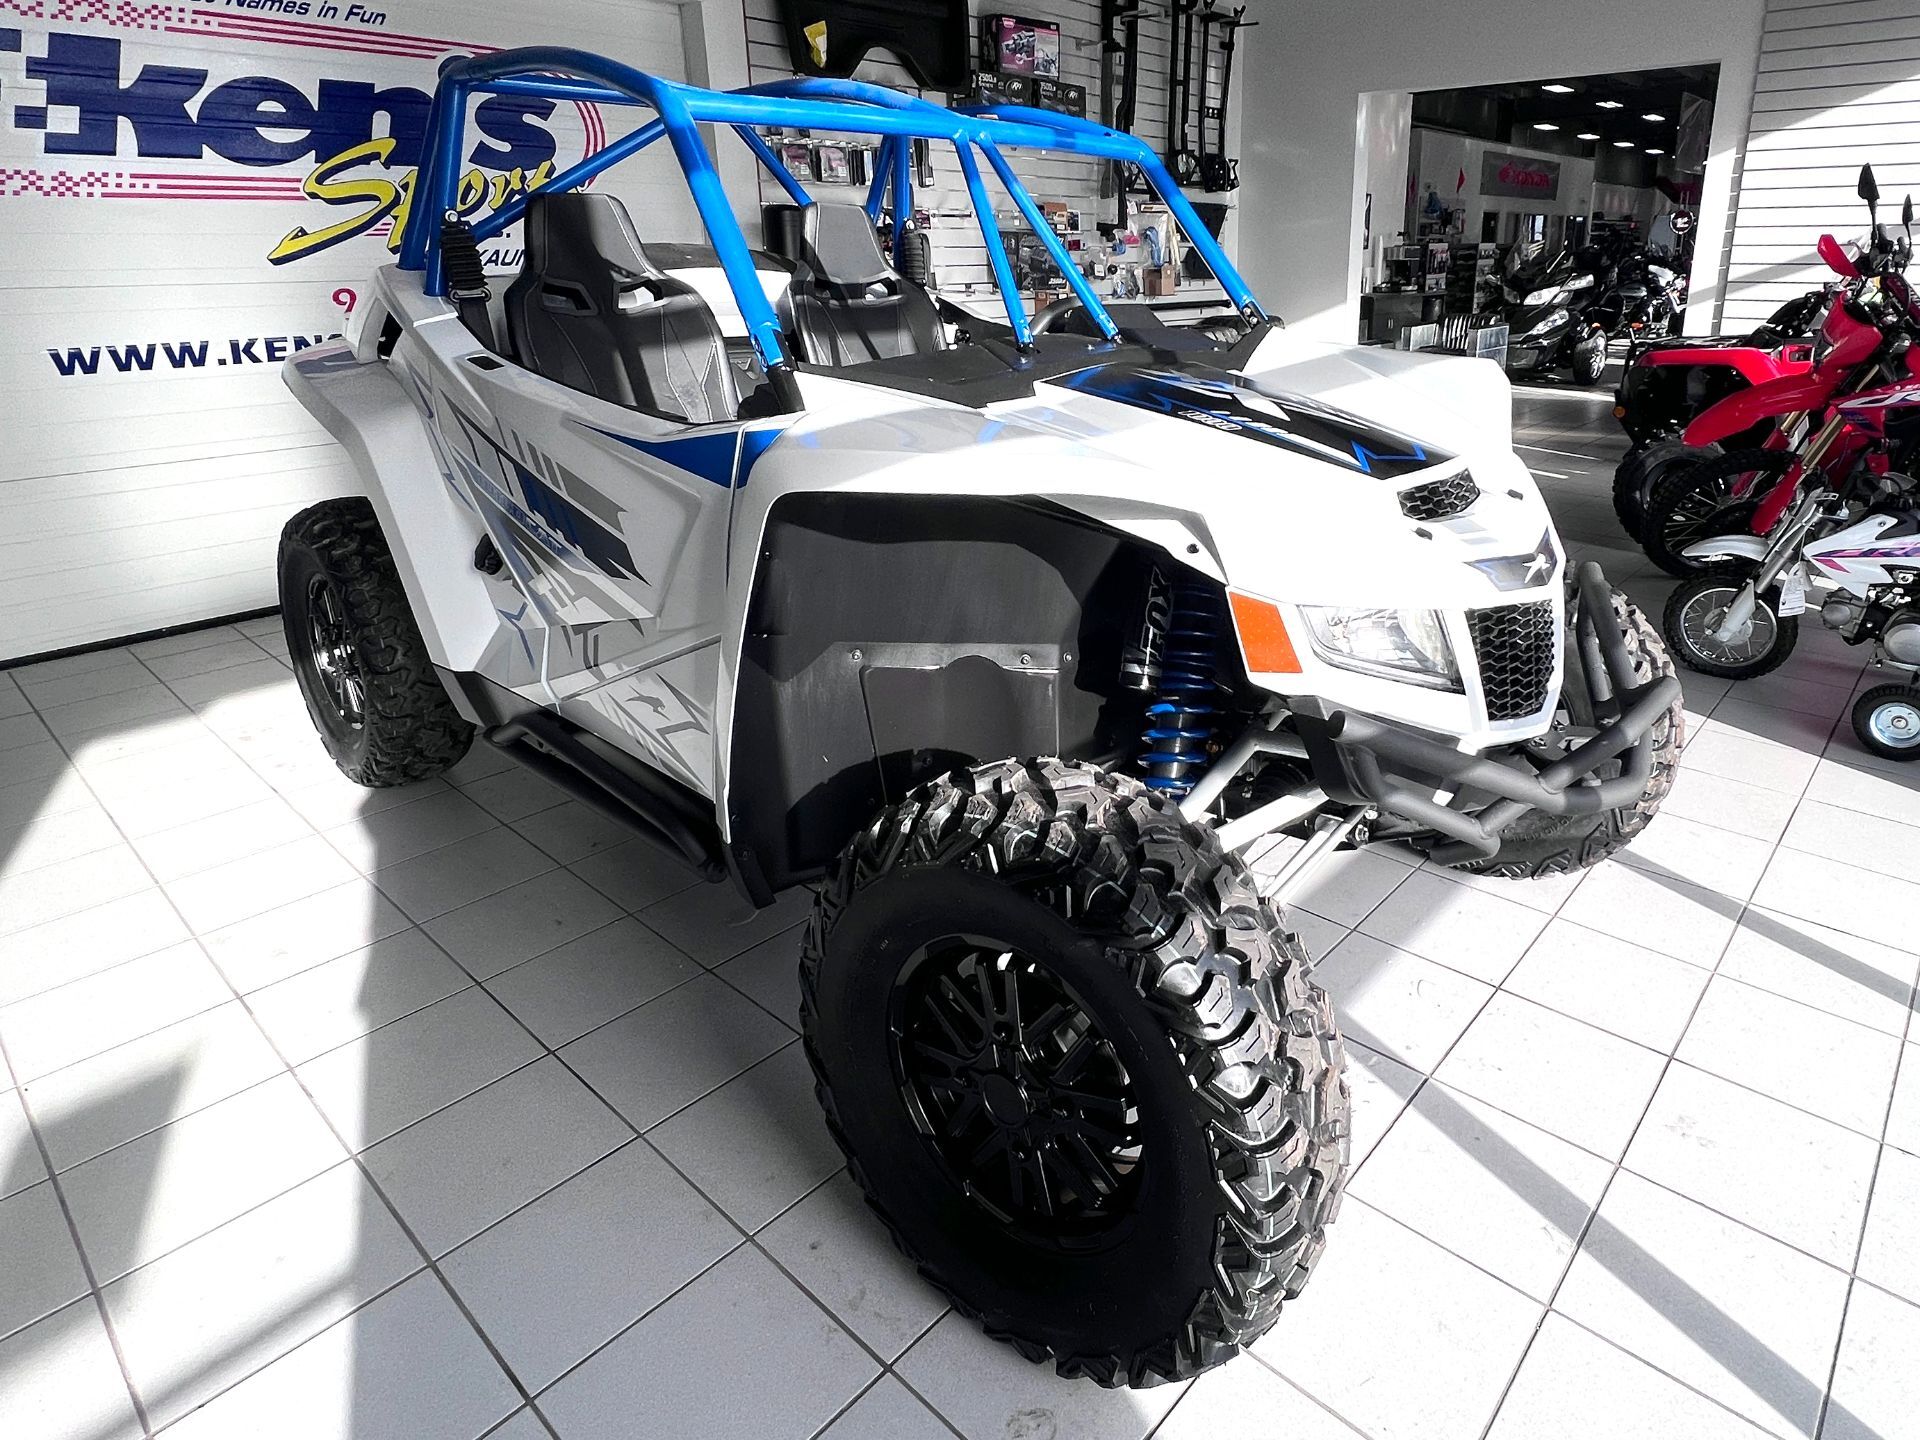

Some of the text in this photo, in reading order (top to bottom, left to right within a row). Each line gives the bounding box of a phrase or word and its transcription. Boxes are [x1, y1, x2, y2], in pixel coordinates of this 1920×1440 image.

[317, 0, 343, 18] in
[344, 4, 387, 26] Fun
[1138, 565, 1175, 663] FOX
